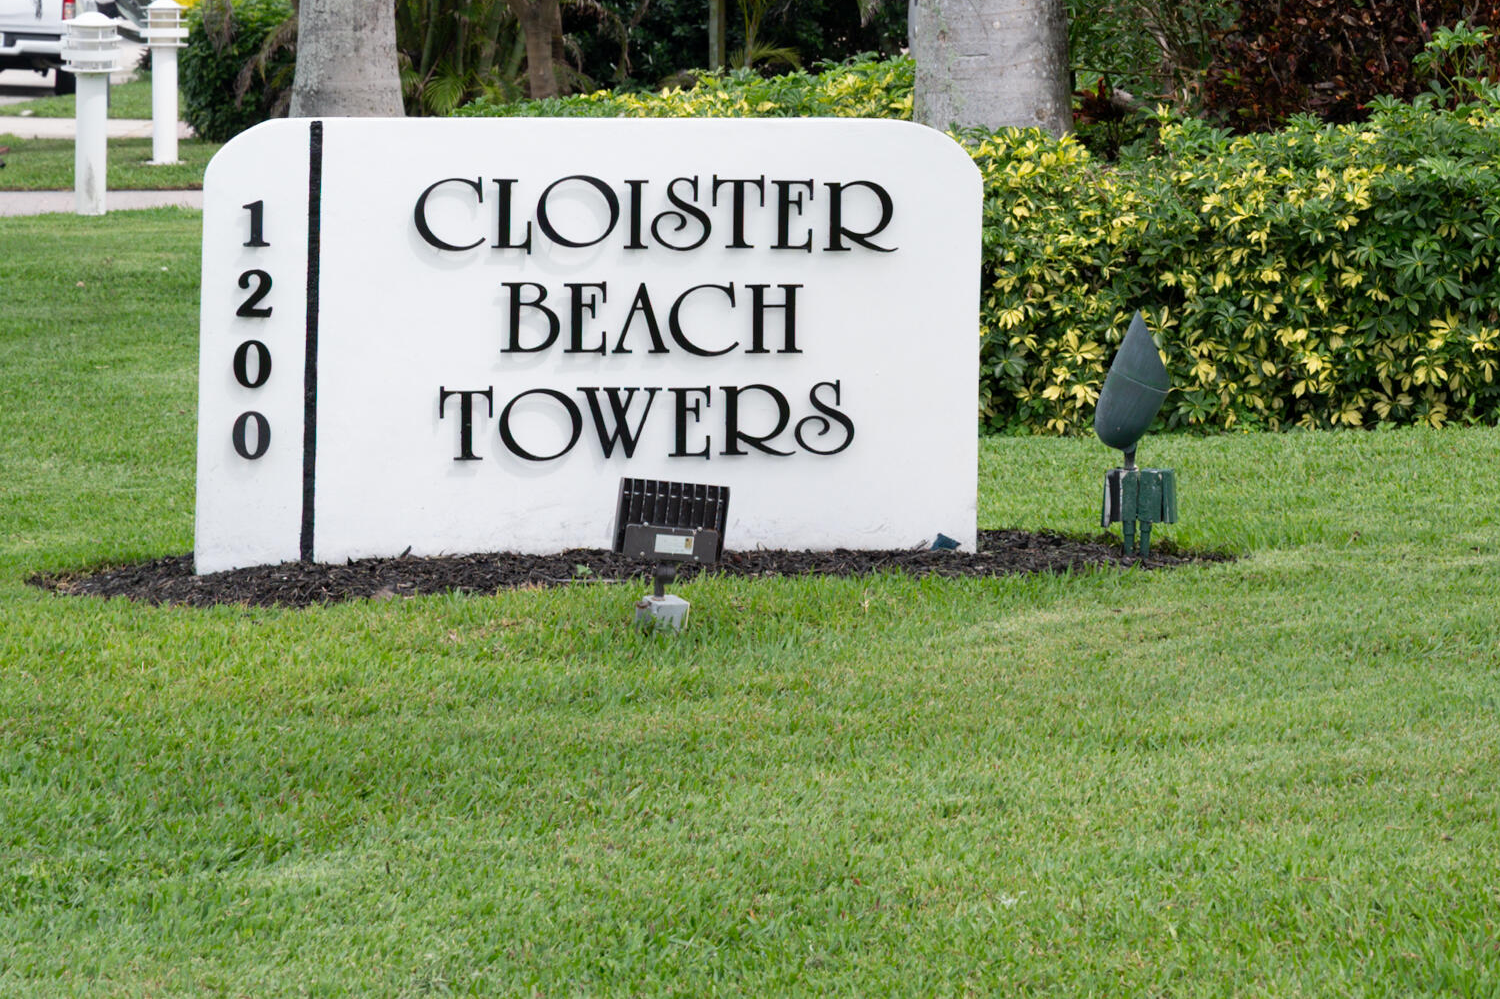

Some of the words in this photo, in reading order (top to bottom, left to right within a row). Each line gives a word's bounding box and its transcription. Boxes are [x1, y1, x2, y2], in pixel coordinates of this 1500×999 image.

[413, 174, 900, 256] CLOISTER
[232, 200, 273, 461] 1200
[500, 281, 804, 358] BEACH
[439, 379, 856, 462] TOWERS
